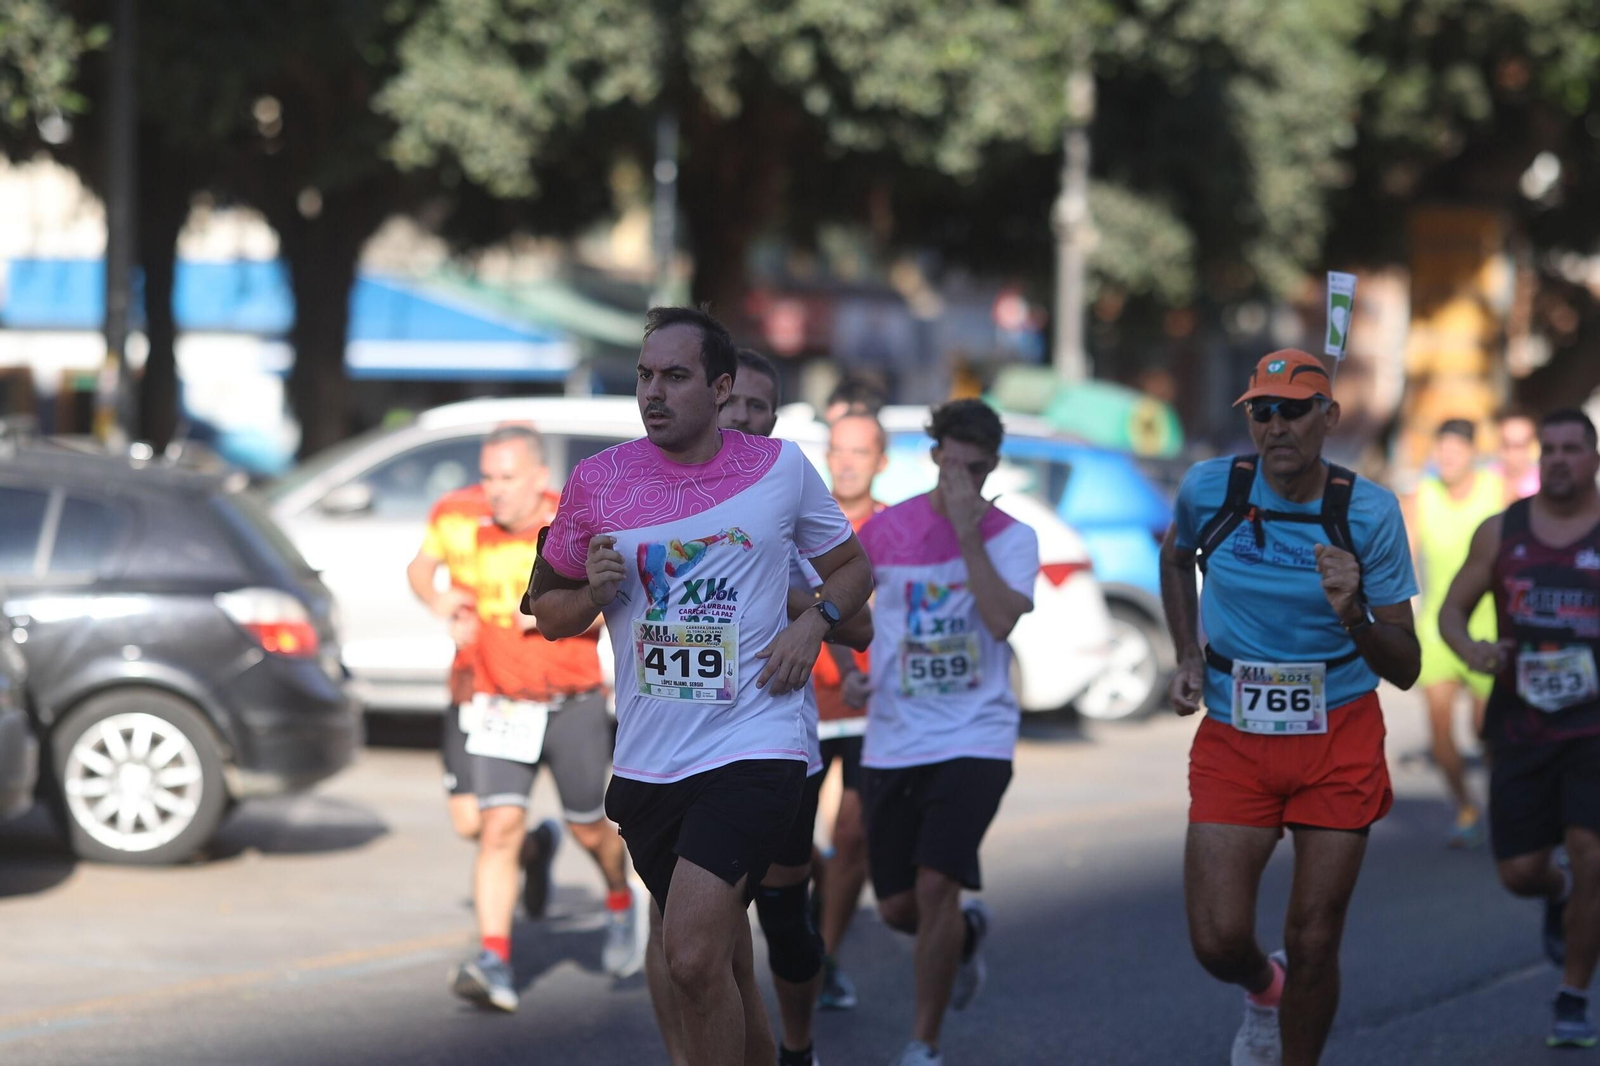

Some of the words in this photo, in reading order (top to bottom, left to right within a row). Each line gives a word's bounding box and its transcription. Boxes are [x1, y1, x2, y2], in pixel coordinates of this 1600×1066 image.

[707, 603, 736, 611] URBANA
[659, 633, 679, 643] 10k
[685, 633, 721, 643] 2025
[645, 647, 722, 679] 419
[911, 655, 969, 679] 569
[1278, 674, 1311, 683] 2025
[1244, 687, 1311, 712] 766
